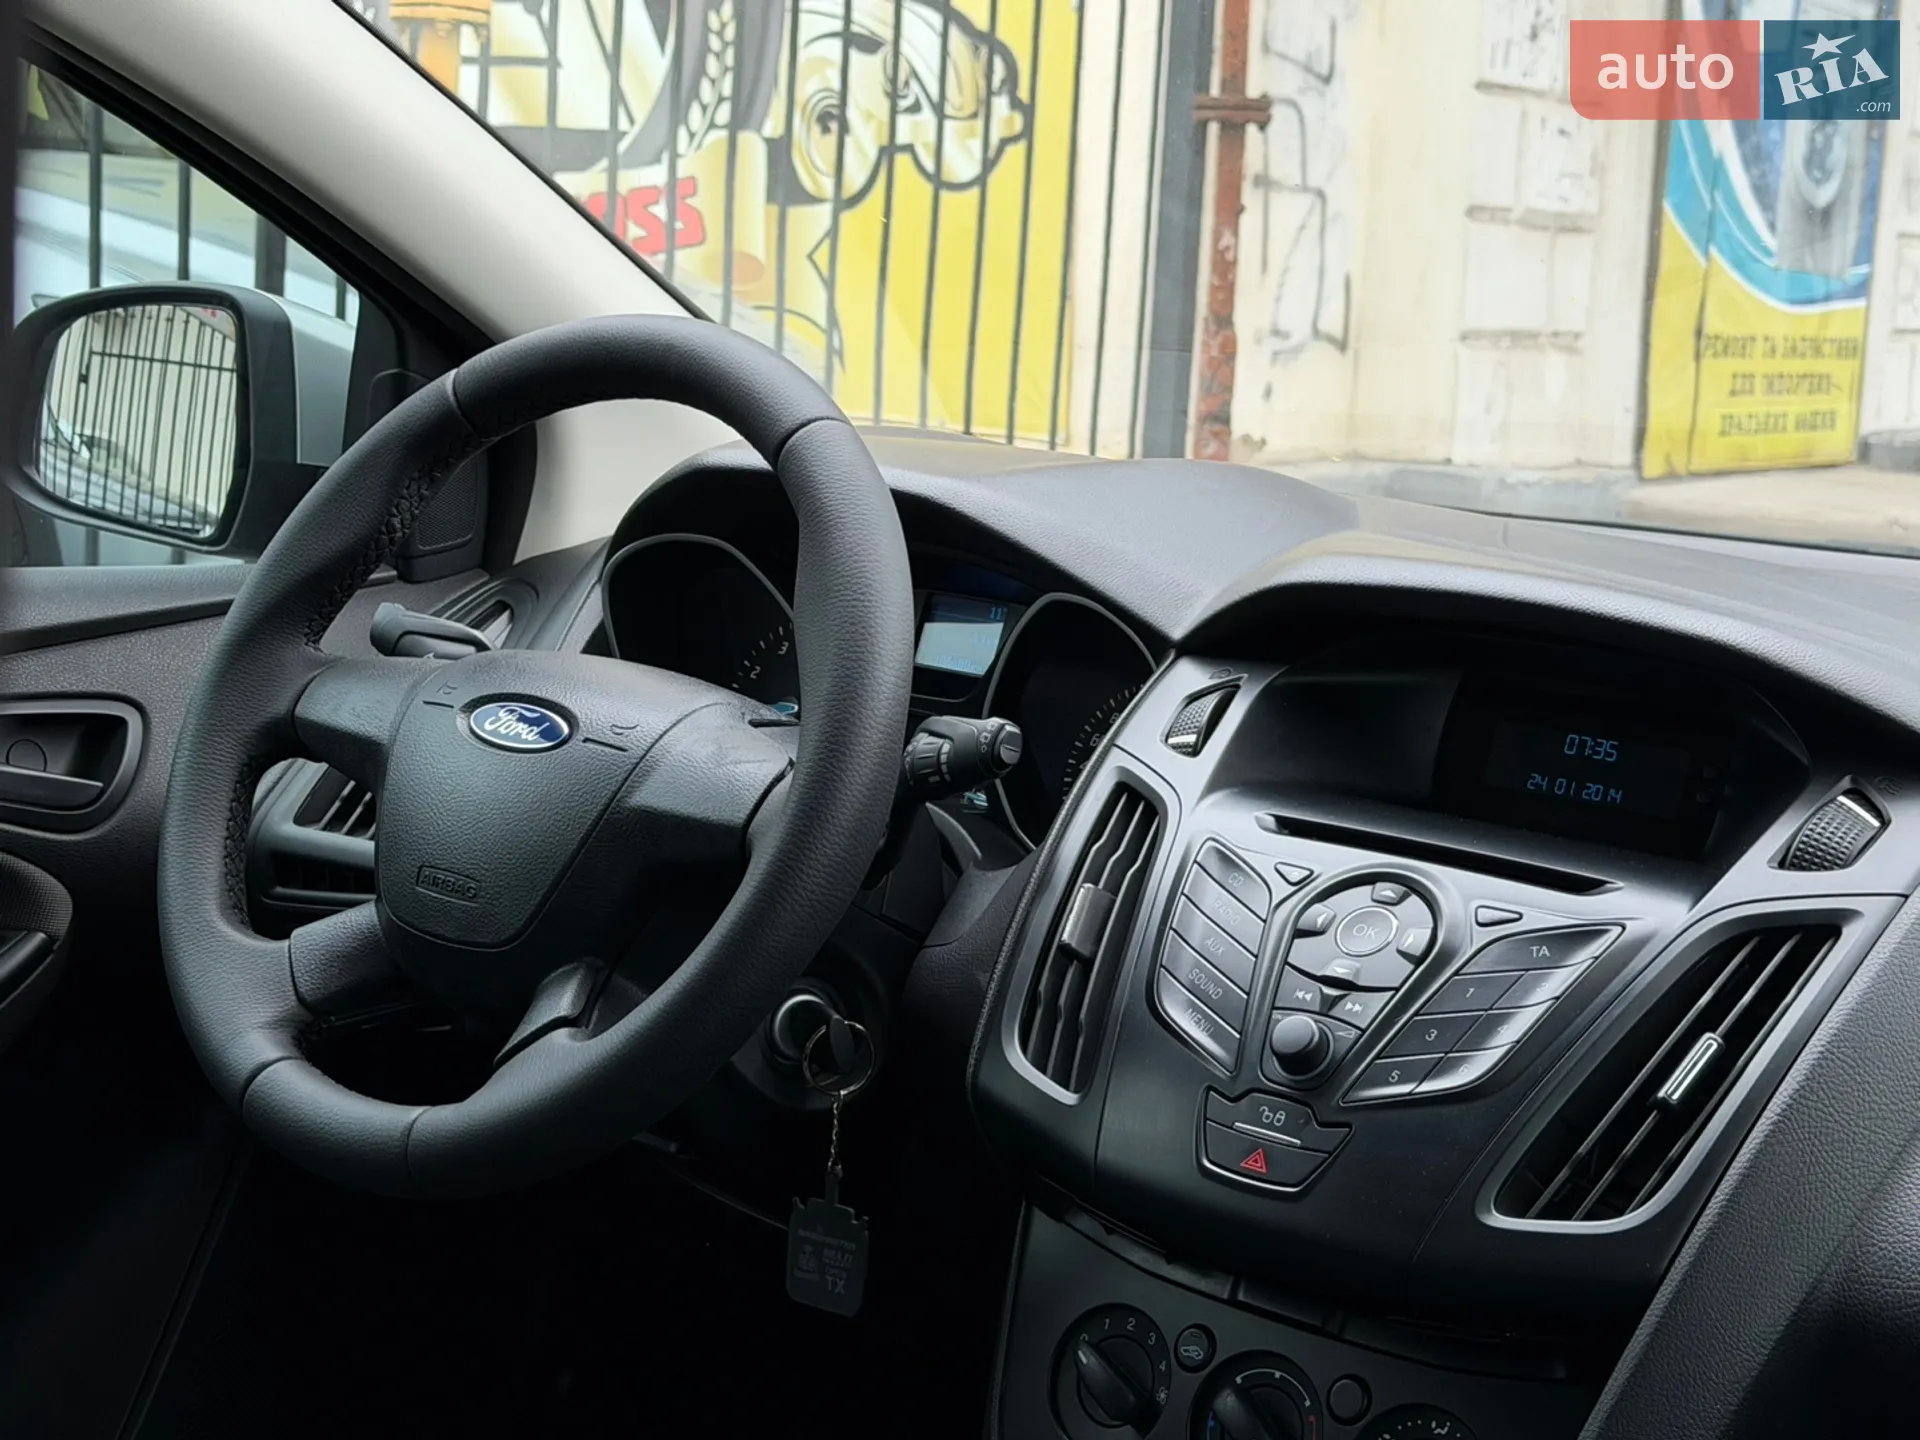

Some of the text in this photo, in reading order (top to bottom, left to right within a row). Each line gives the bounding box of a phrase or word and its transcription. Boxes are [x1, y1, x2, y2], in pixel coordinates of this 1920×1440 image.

[777, 641, 790, 655] 3
[750, 665, 761, 679] 2
[483, 706, 551, 741] Ford
[1563, 733, 1619, 762] 07:35
[420, 871, 478, 898] AIRBAG
[1227, 872, 1244, 887] CD
[1211, 899, 1241, 925] RADIO
[1353, 923, 1378, 942] OK
[1204, 937, 1226, 957] AUX
[1530, 944, 1551, 959] TA
[1188, 967, 1223, 1000] SOUND
[1466, 987, 1474, 998] 1
[1184, 1007, 1215, 1037] MENU
[1426, 1022, 1508, 1042] 3 4
[1390, 1063, 1471, 1083] 5 6
[1103, 1317, 1136, 1331] 1 2
[1147, 1332, 1156, 1345] 3
[1158, 1360, 1167, 1373] 4
